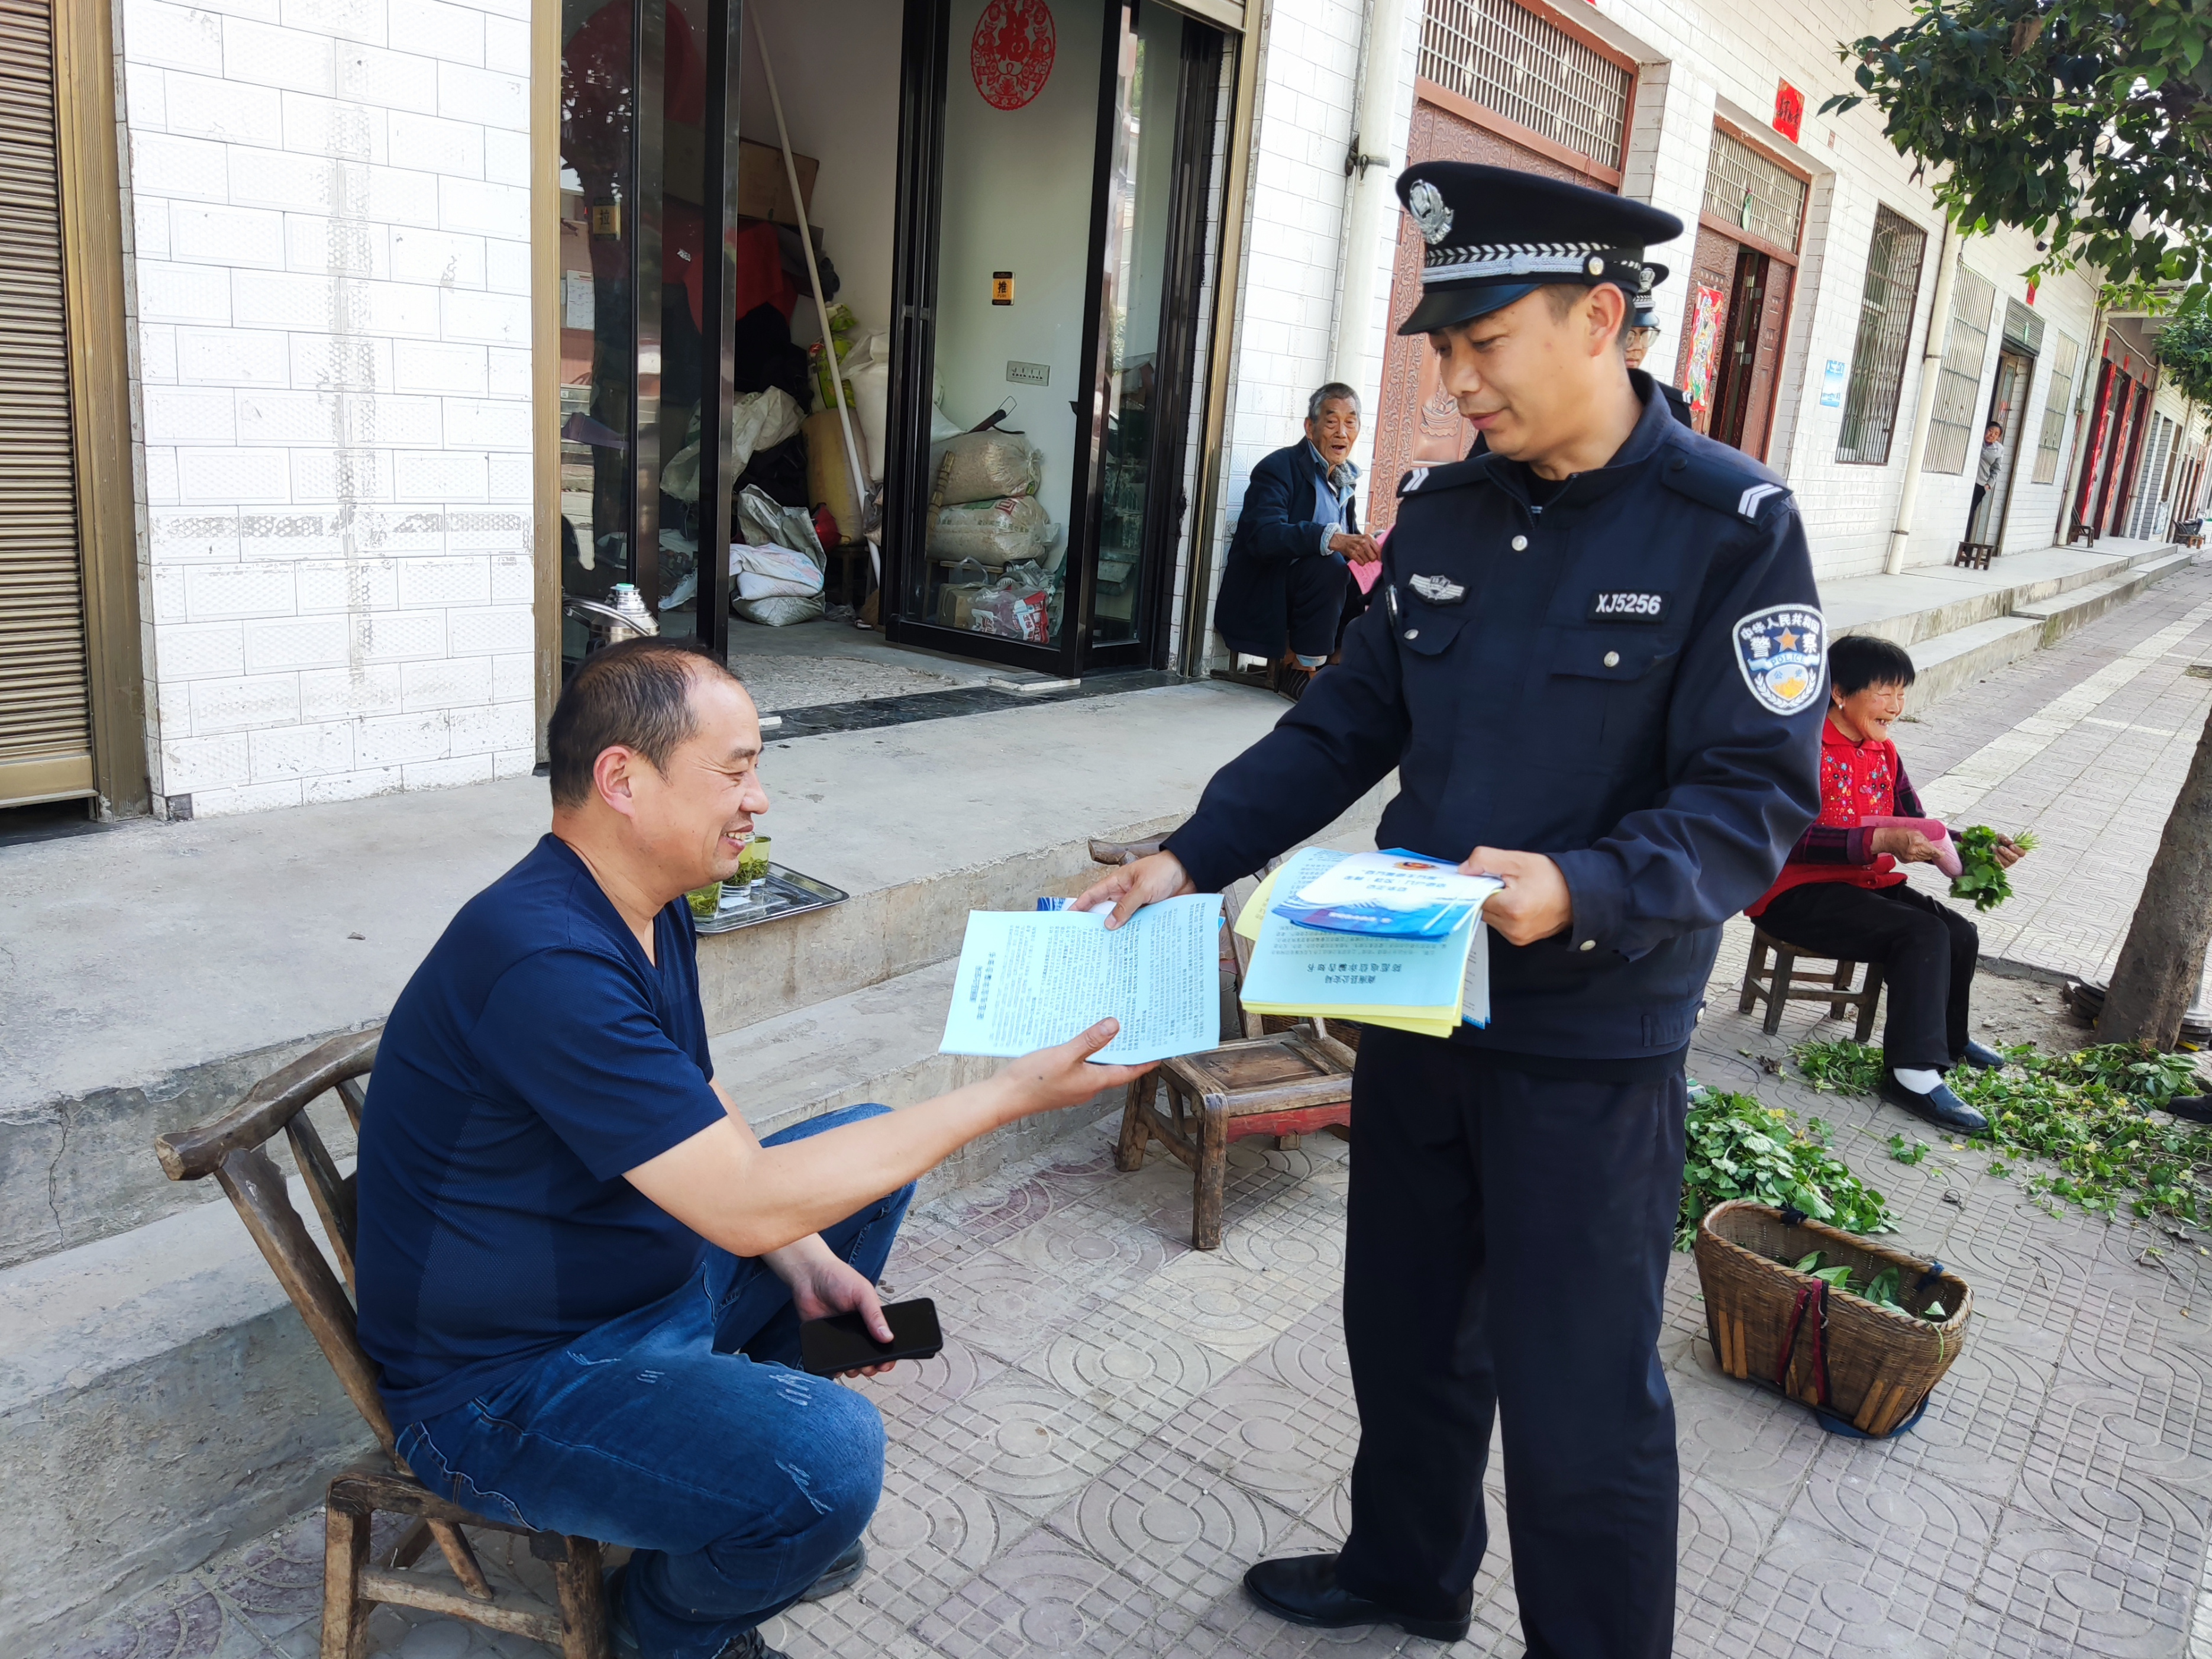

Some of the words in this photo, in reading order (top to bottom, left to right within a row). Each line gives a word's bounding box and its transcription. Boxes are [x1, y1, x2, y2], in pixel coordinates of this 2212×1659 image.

[599, 209, 610, 225] 拉
[997, 280, 1007, 293] 推
[1596, 593, 1662, 615] XJ5256
[1740, 613, 1820, 640] 中华人民共和国
[1749, 632, 1817, 659] 警察
[1770, 654, 1804, 666] POLICE
